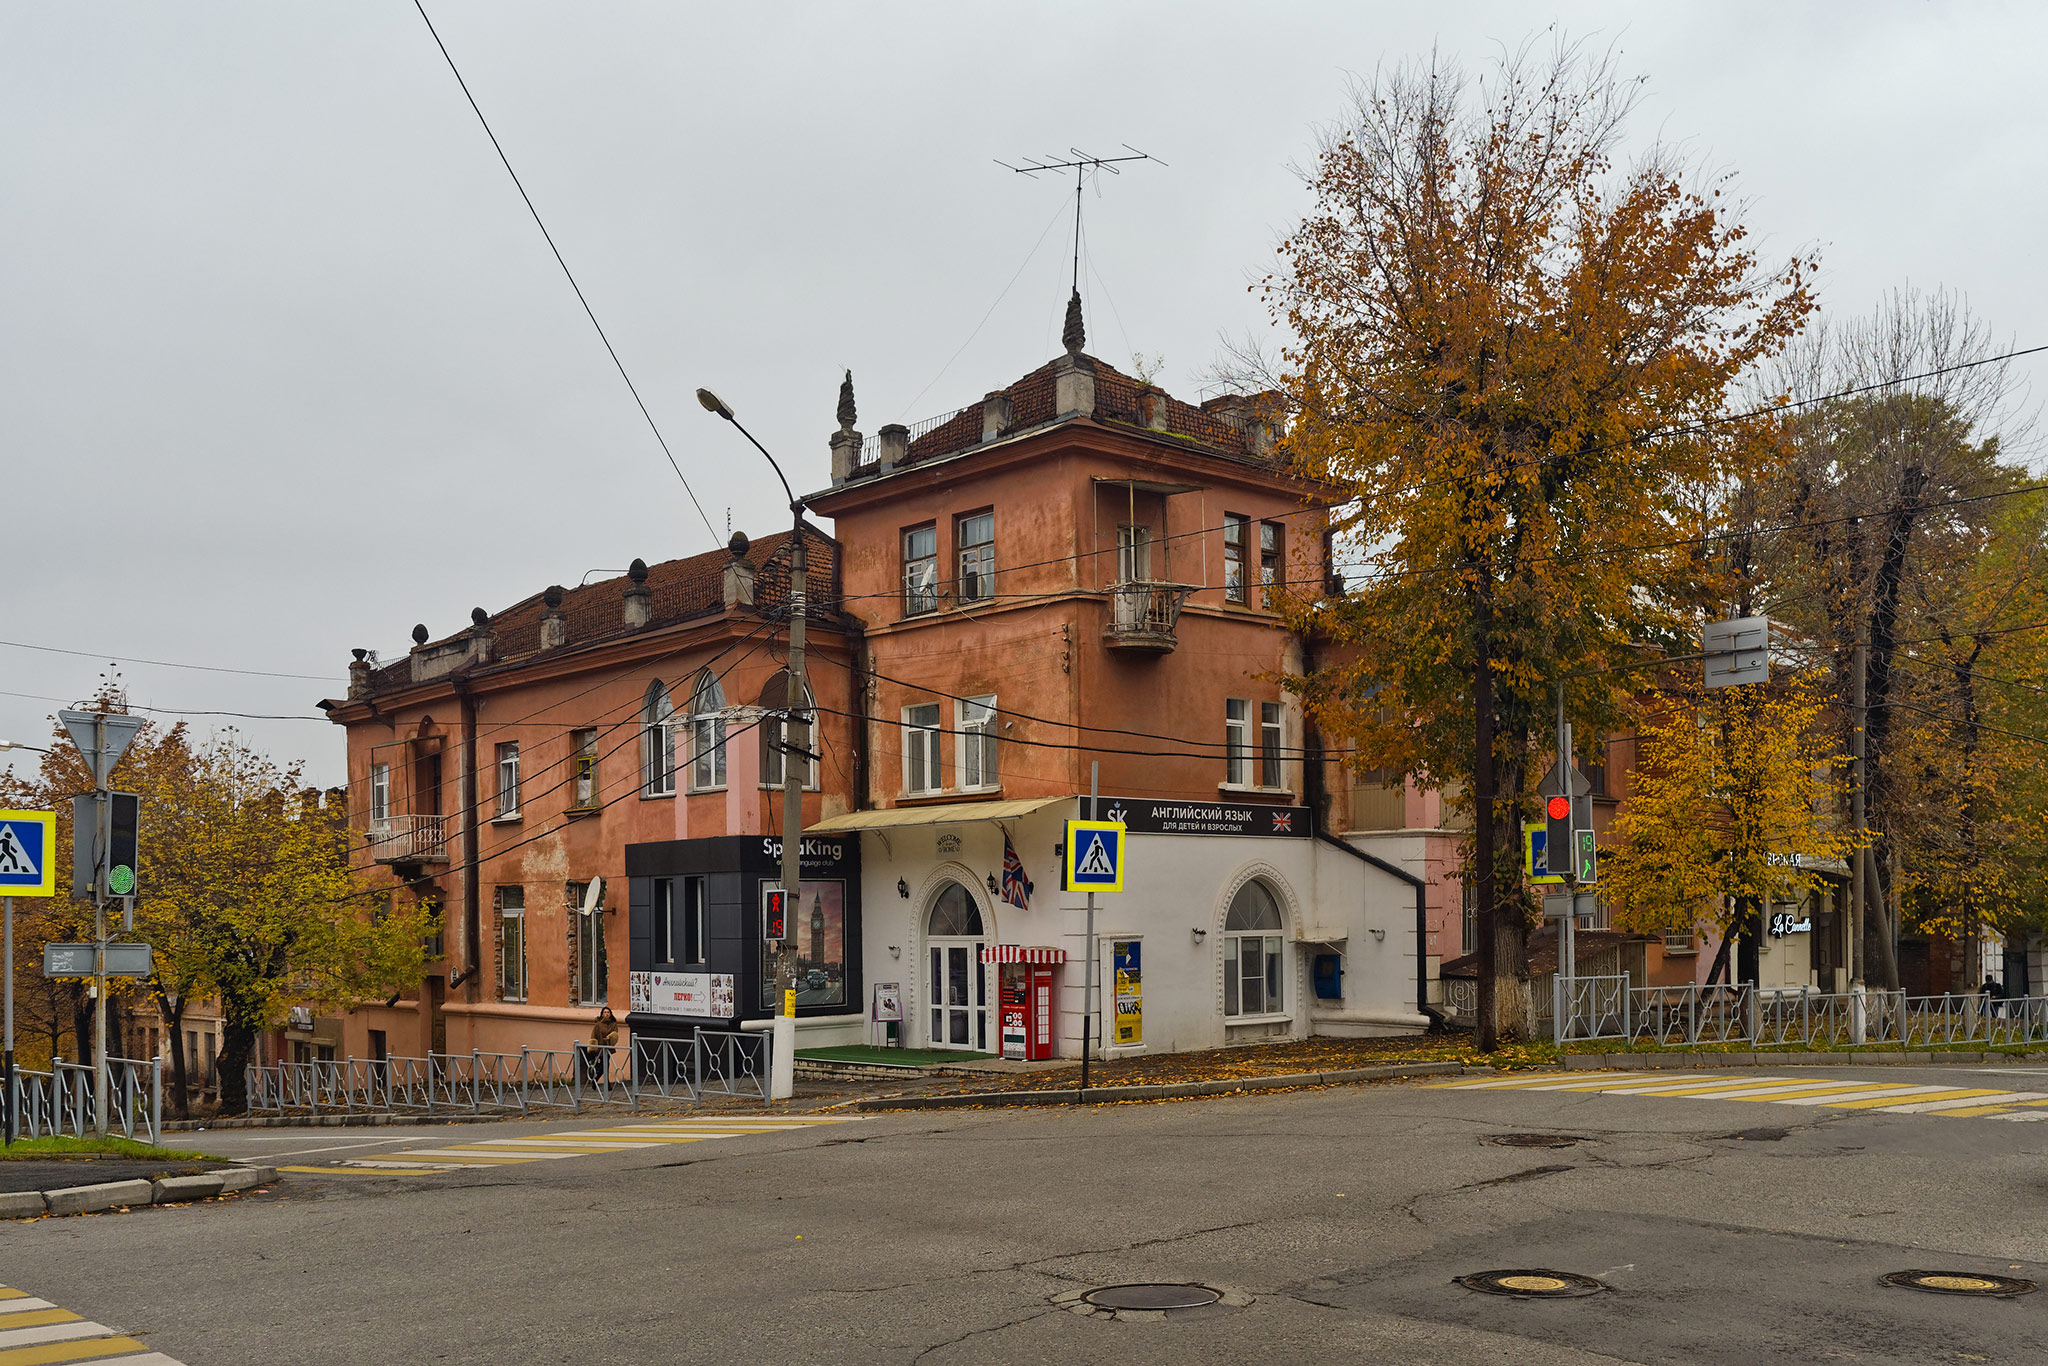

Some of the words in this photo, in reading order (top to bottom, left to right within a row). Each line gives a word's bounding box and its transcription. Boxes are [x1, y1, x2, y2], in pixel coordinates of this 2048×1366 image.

[1151, 805, 1222, 821] АНГЛИЙСКИЙ
[1225, 808, 1253, 822] ЯЗЫК
[1162, 821, 1178, 831] ДЛЯ
[1178, 821, 1200, 831] ДЕТЕЙ
[1201, 822, 1207, 831] И
[1207, 822, 1243, 832] ВЗРОСЛЫХ
[1582, 835, 1593, 852] 19
[772, 919, 784, 936] 19
